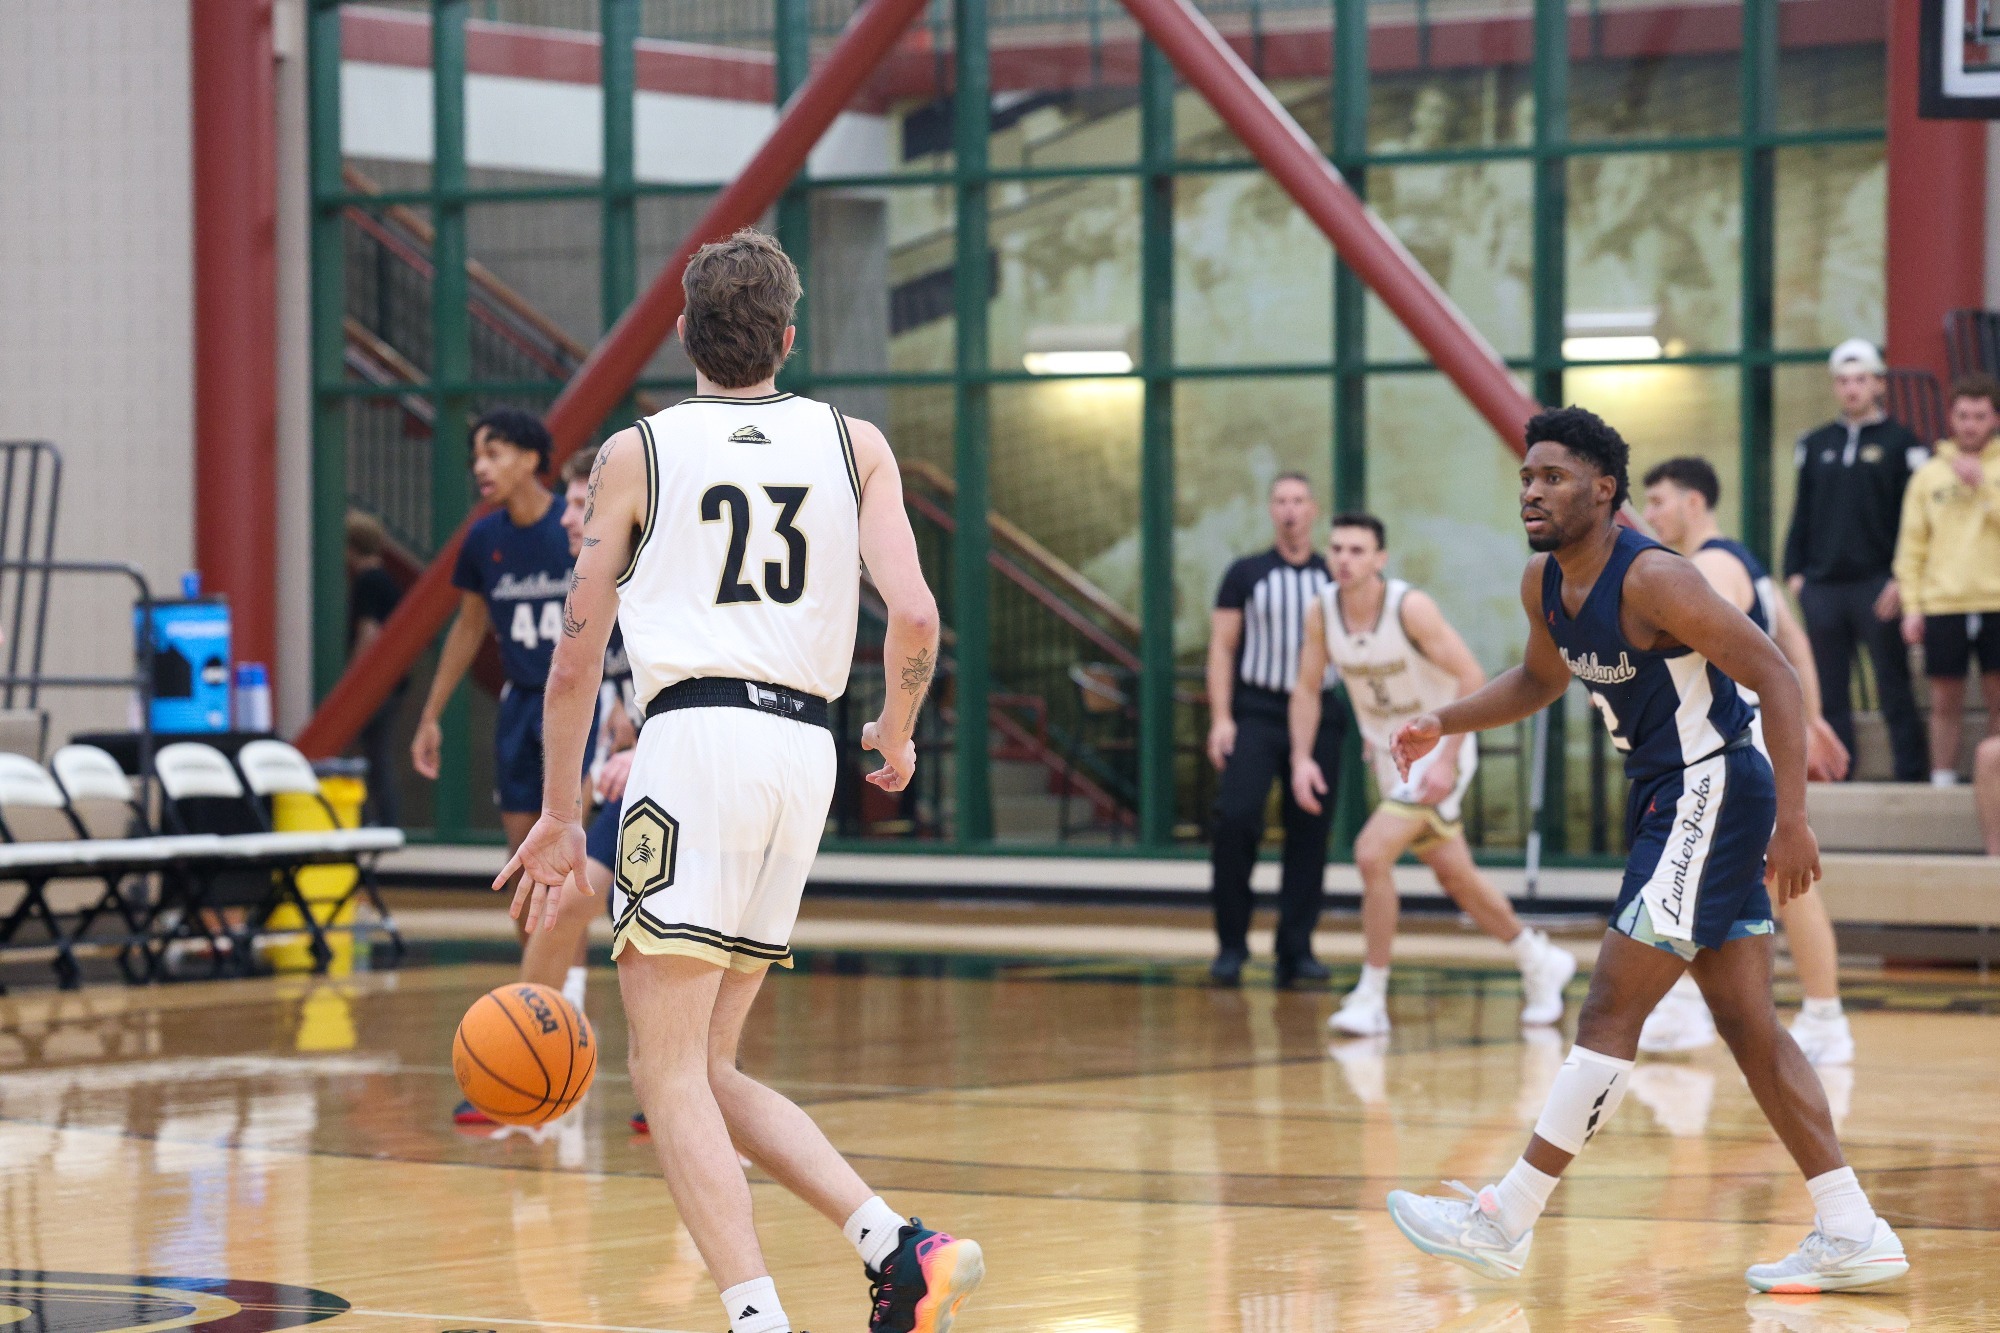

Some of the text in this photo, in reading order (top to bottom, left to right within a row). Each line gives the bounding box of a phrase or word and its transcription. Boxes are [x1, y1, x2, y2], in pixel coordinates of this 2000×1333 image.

[698, 481, 813, 607] 23
[511, 601, 566, 648] 44
[1661, 774, 1711, 926] LumberJacks
